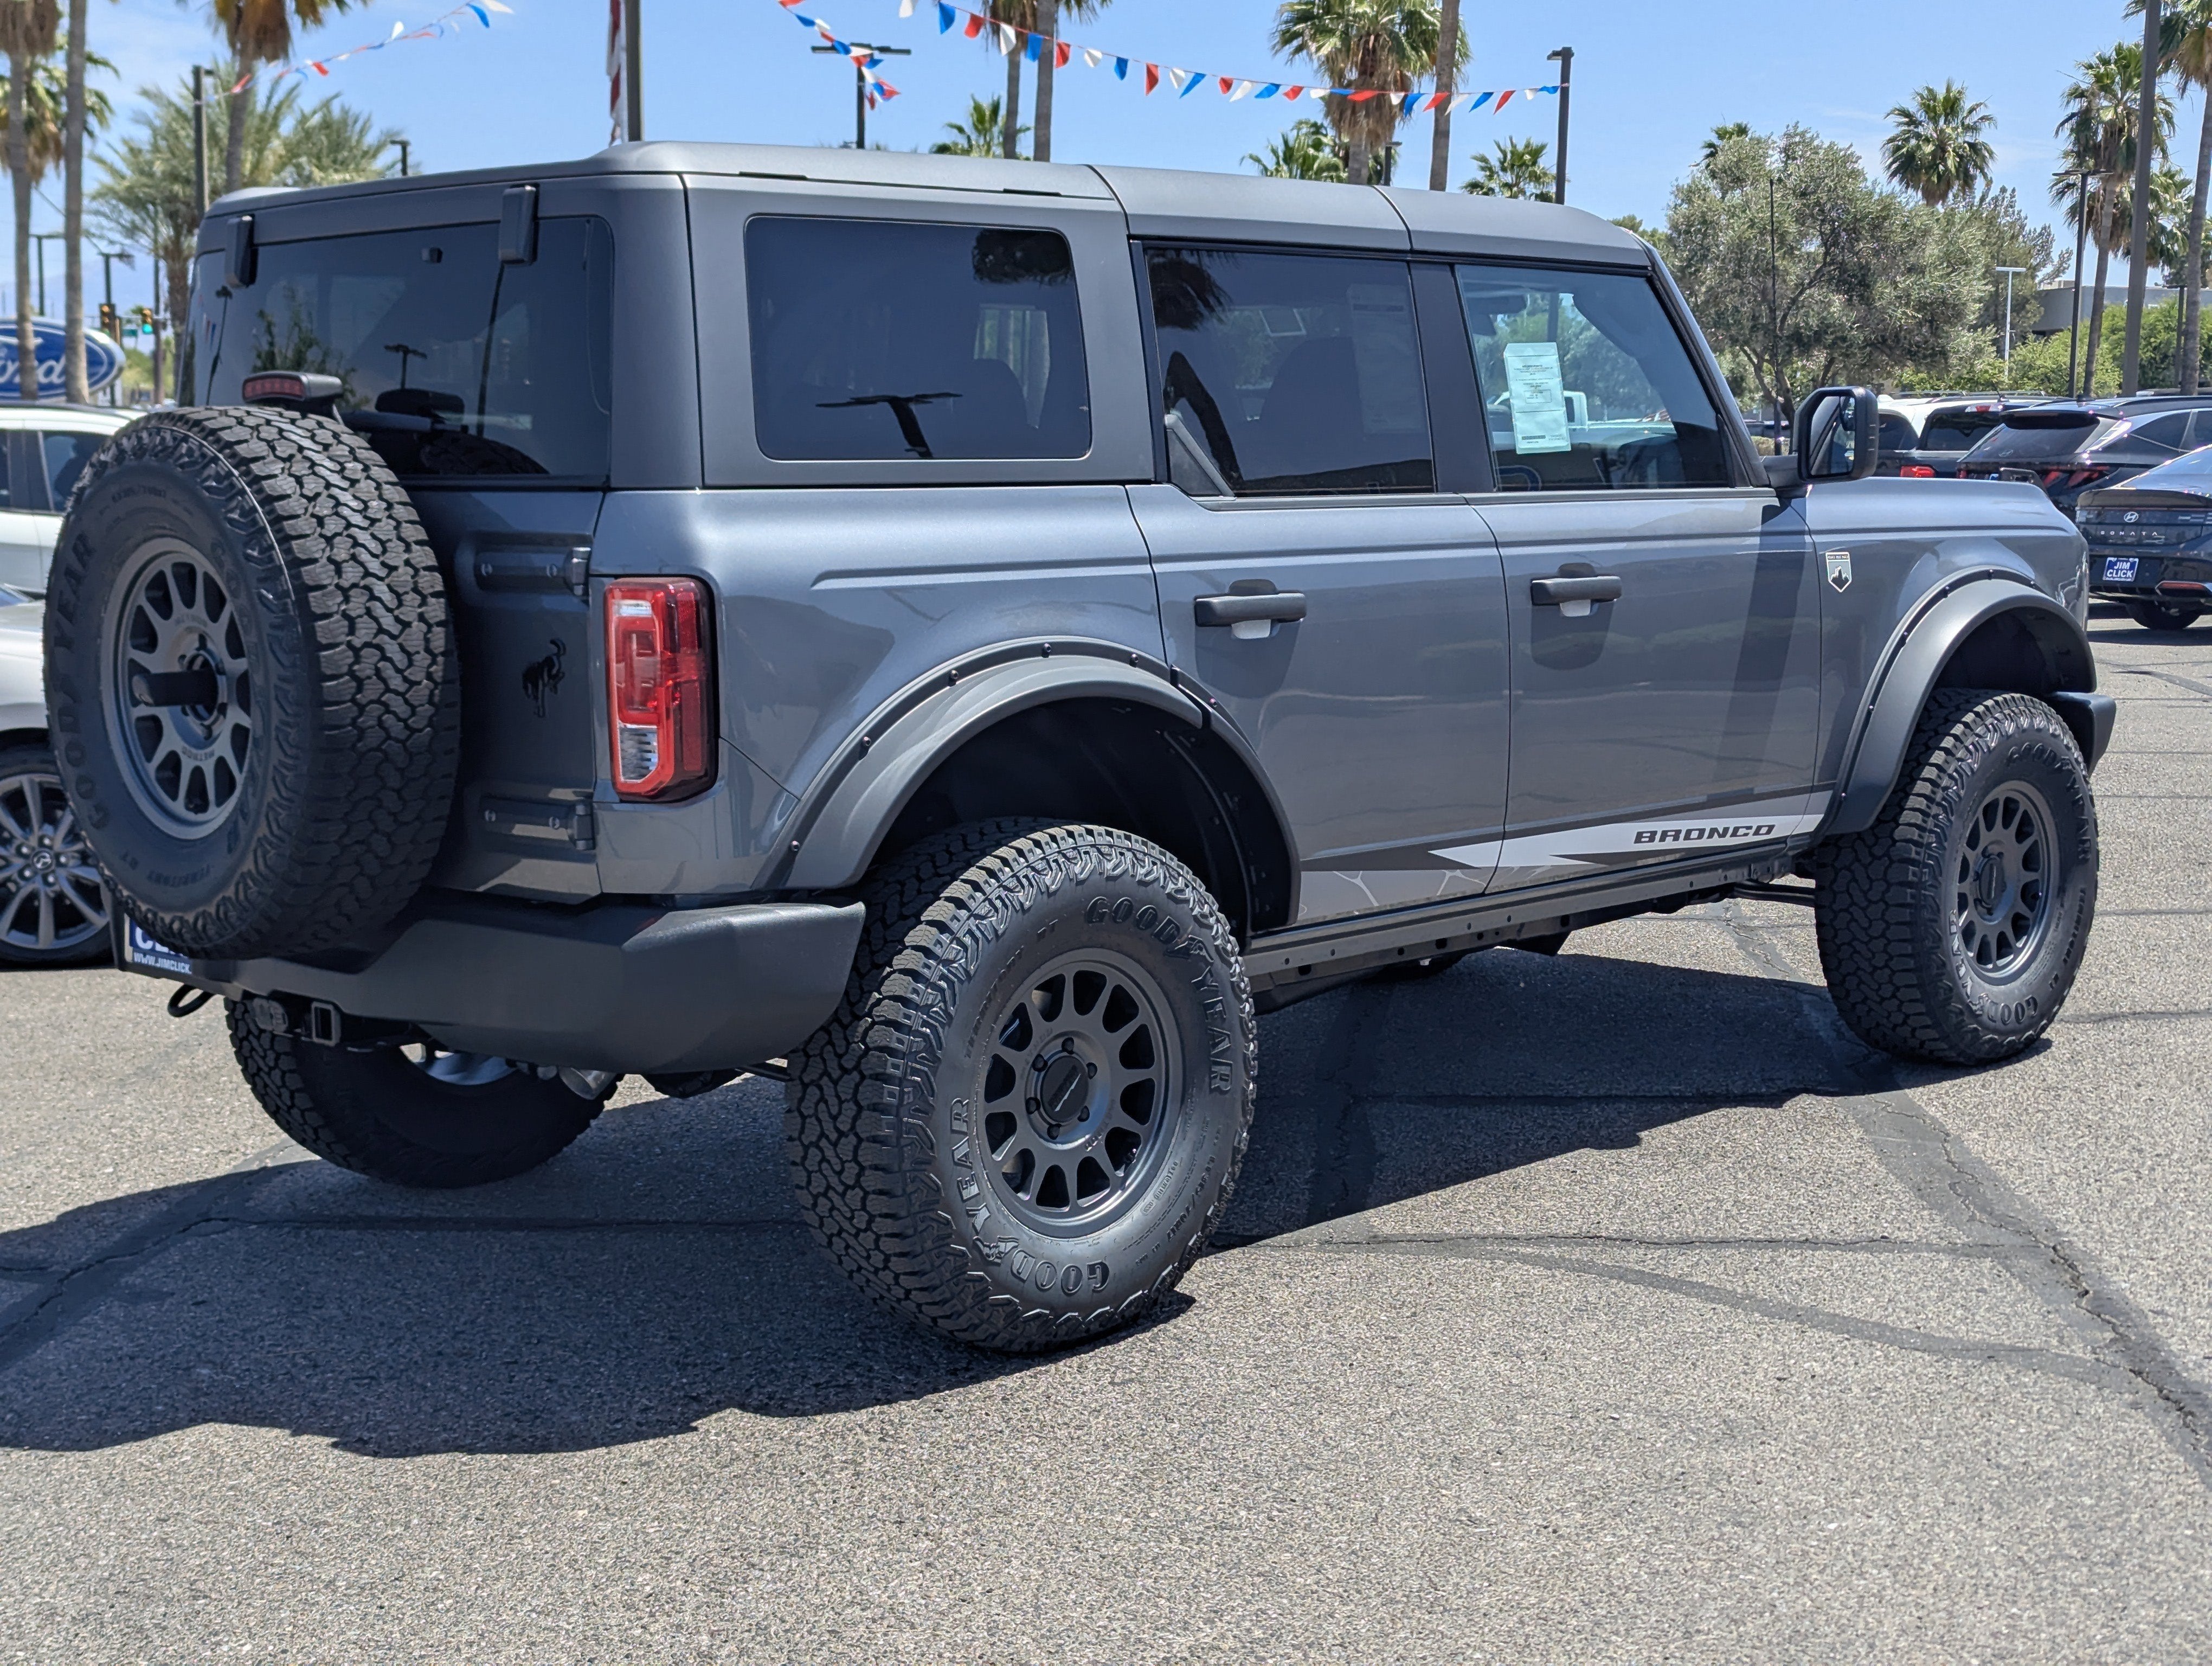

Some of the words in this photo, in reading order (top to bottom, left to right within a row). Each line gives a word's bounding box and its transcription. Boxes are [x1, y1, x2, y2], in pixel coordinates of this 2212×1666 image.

[2114, 561, 2131, 569] JIM
[2107, 569, 2133, 578] CLICK
[1634, 824, 1776, 844] BRONCO
